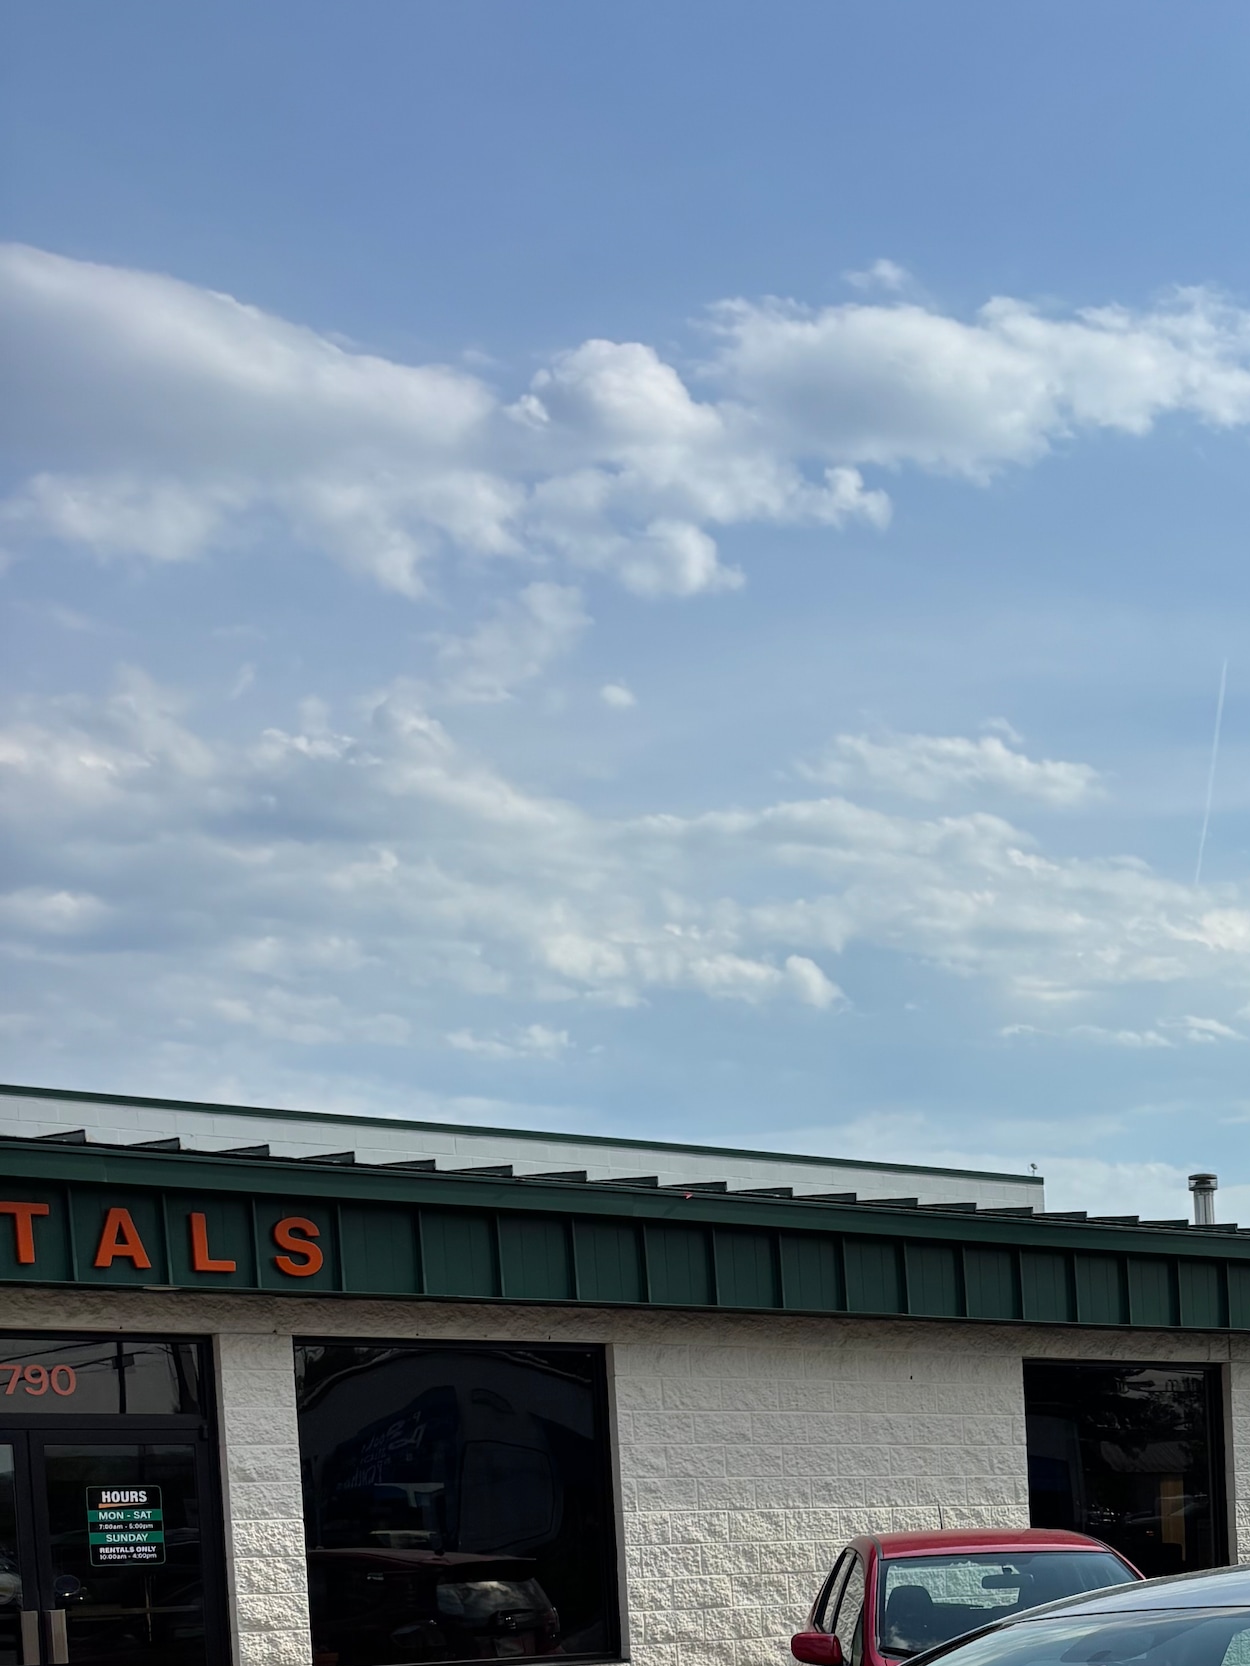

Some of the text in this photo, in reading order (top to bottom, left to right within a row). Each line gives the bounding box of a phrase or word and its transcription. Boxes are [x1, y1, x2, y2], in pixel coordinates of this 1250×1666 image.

[0, 1201, 324, 1277] TALS
[101, 1490, 148, 1502] HOURS
[98, 1511, 124, 1520] MON
[133, 1510, 152, 1519] SAT
[105, 1533, 149, 1542] SUNDAY
[99, 1545, 156, 1554] RENTALS ONLY
